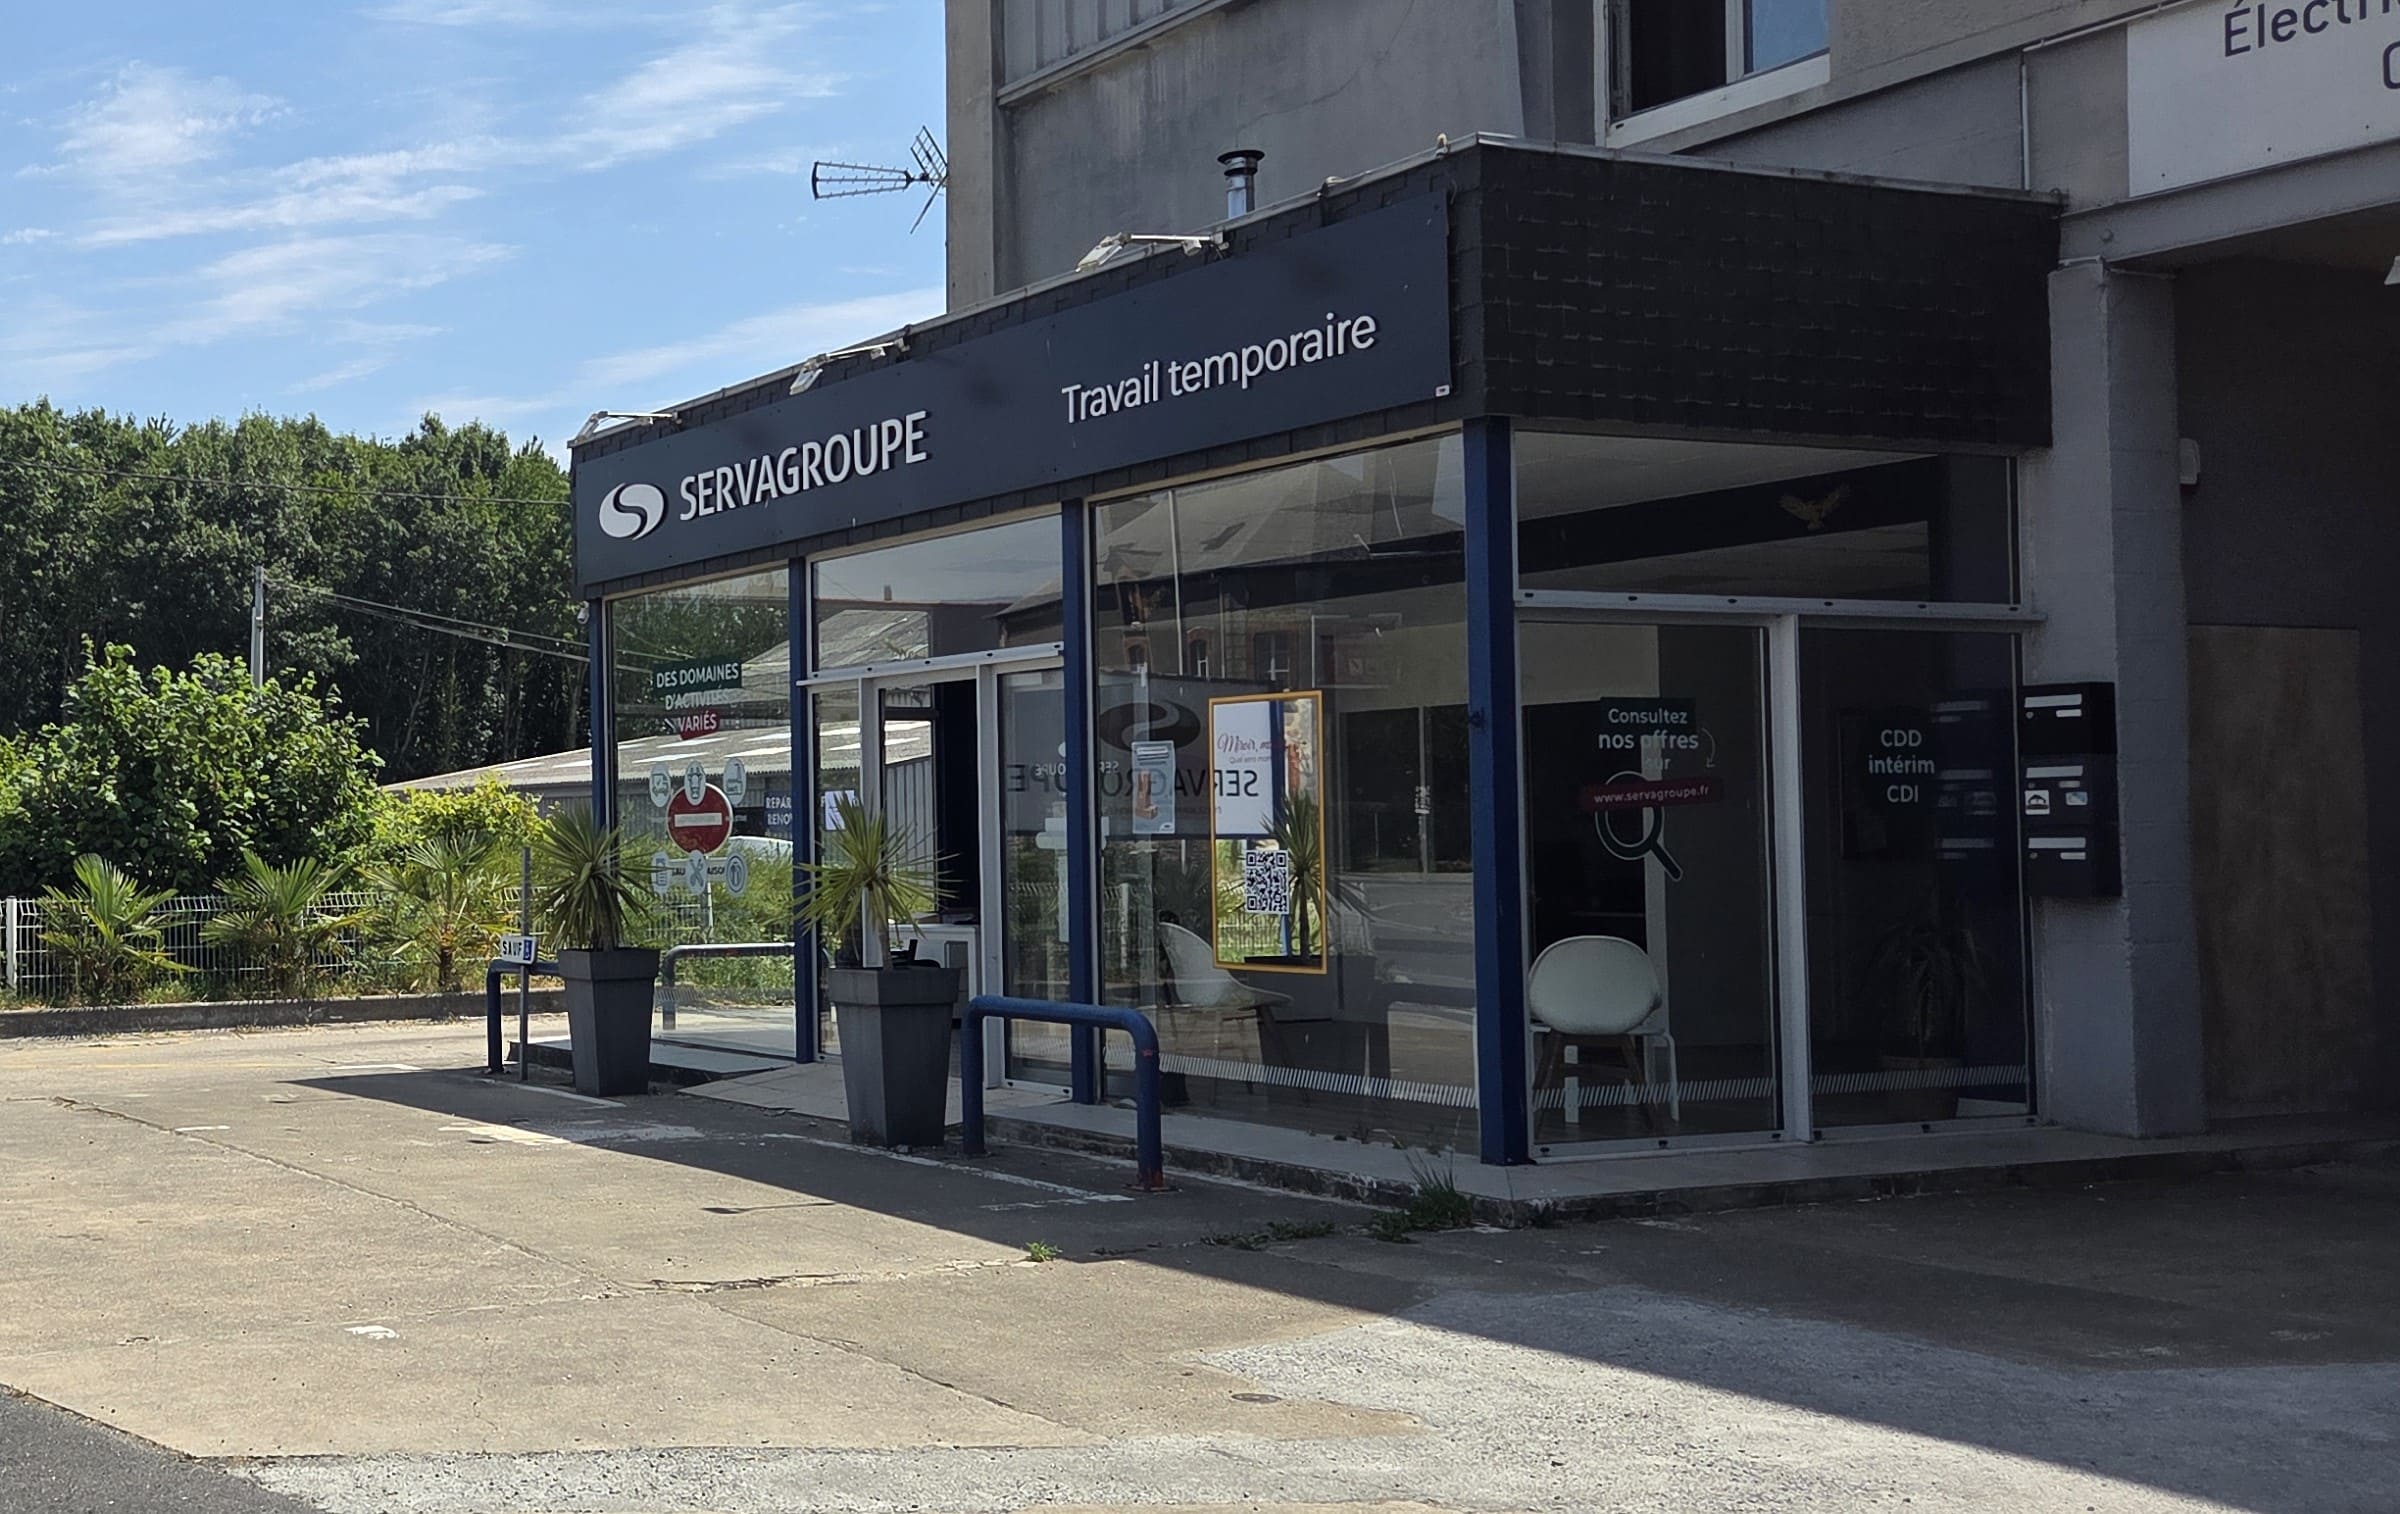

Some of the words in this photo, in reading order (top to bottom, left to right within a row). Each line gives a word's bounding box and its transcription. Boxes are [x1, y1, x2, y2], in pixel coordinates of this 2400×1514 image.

[1061, 359, 1160, 423] Travail
[1167, 312, 1377, 389] temporaire
[680, 410, 928, 521] SERVAGROUPE
[656, 673, 678, 688] DES
[680, 662, 739, 684] DOMAINES
[678, 710, 717, 731] VARIÉS
[1608, 707, 1688, 724] Consultez
[1599, 733, 1634, 749] nos
[1642, 730, 1699, 749] offres
[1880, 729, 1923, 748] CDD
[1868, 753, 1935, 774] intérim
[1594, 784, 1710, 804] www.servagroupe.fr
[1886, 784, 1919, 803] CDI
[502, 940, 522, 956] SAUF
